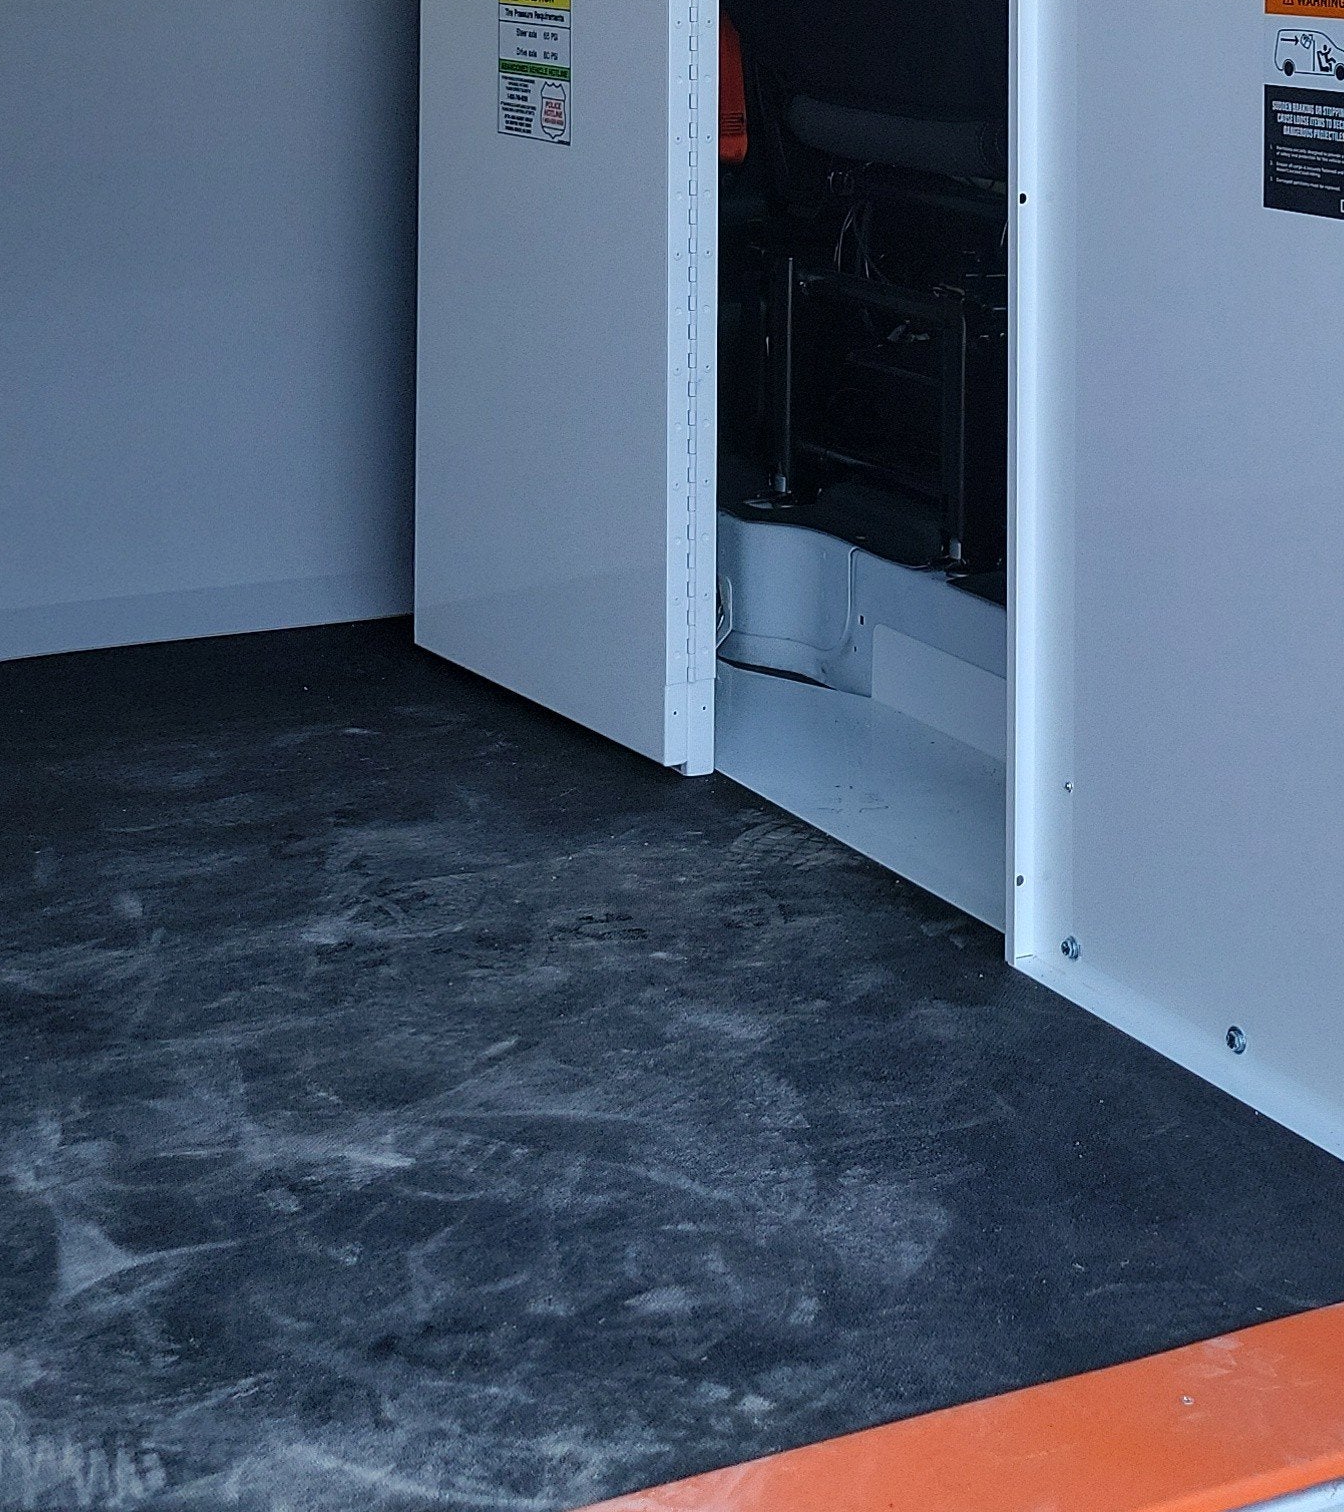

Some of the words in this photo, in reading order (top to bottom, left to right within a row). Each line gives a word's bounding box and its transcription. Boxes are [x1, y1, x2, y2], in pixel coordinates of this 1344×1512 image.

[1272, 101, 1292, 111] SUDDEN
[1277, 113, 1293, 123] CAUSE
[1293, 115, 1309, 125] LOOSE
[1326, 118, 1333, 128] TO
[1283, 125, 1313, 138] DANGEROUS
